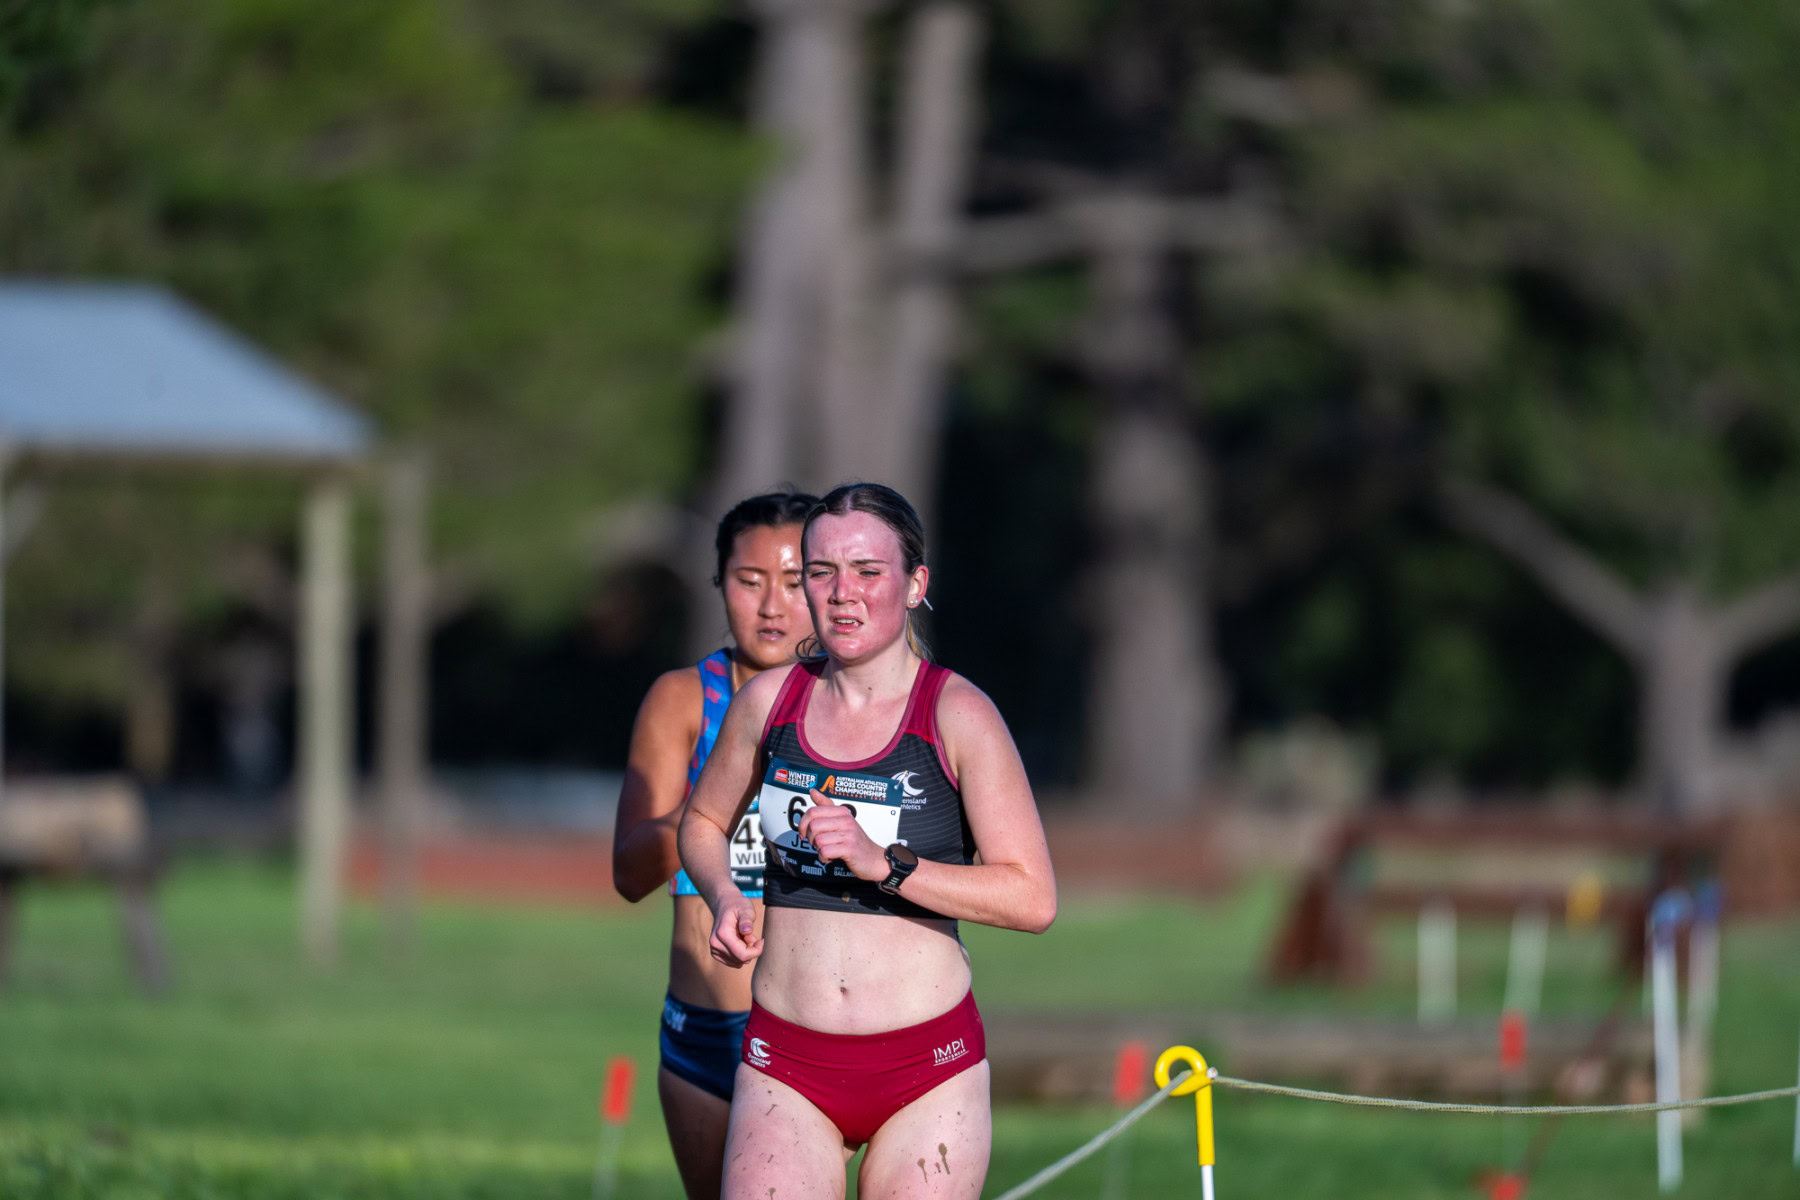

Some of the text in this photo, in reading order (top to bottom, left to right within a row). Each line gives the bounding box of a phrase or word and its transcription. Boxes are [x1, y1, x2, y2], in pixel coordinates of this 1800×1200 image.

[788, 771, 816, 782] WINTER
[788, 778, 809, 788] SERIES
[835, 780, 887, 792] CROSS COUNTRY
[834, 786, 887, 798] CHAMPIONSHIPS
[933, 1038, 965, 1060] IMPI
